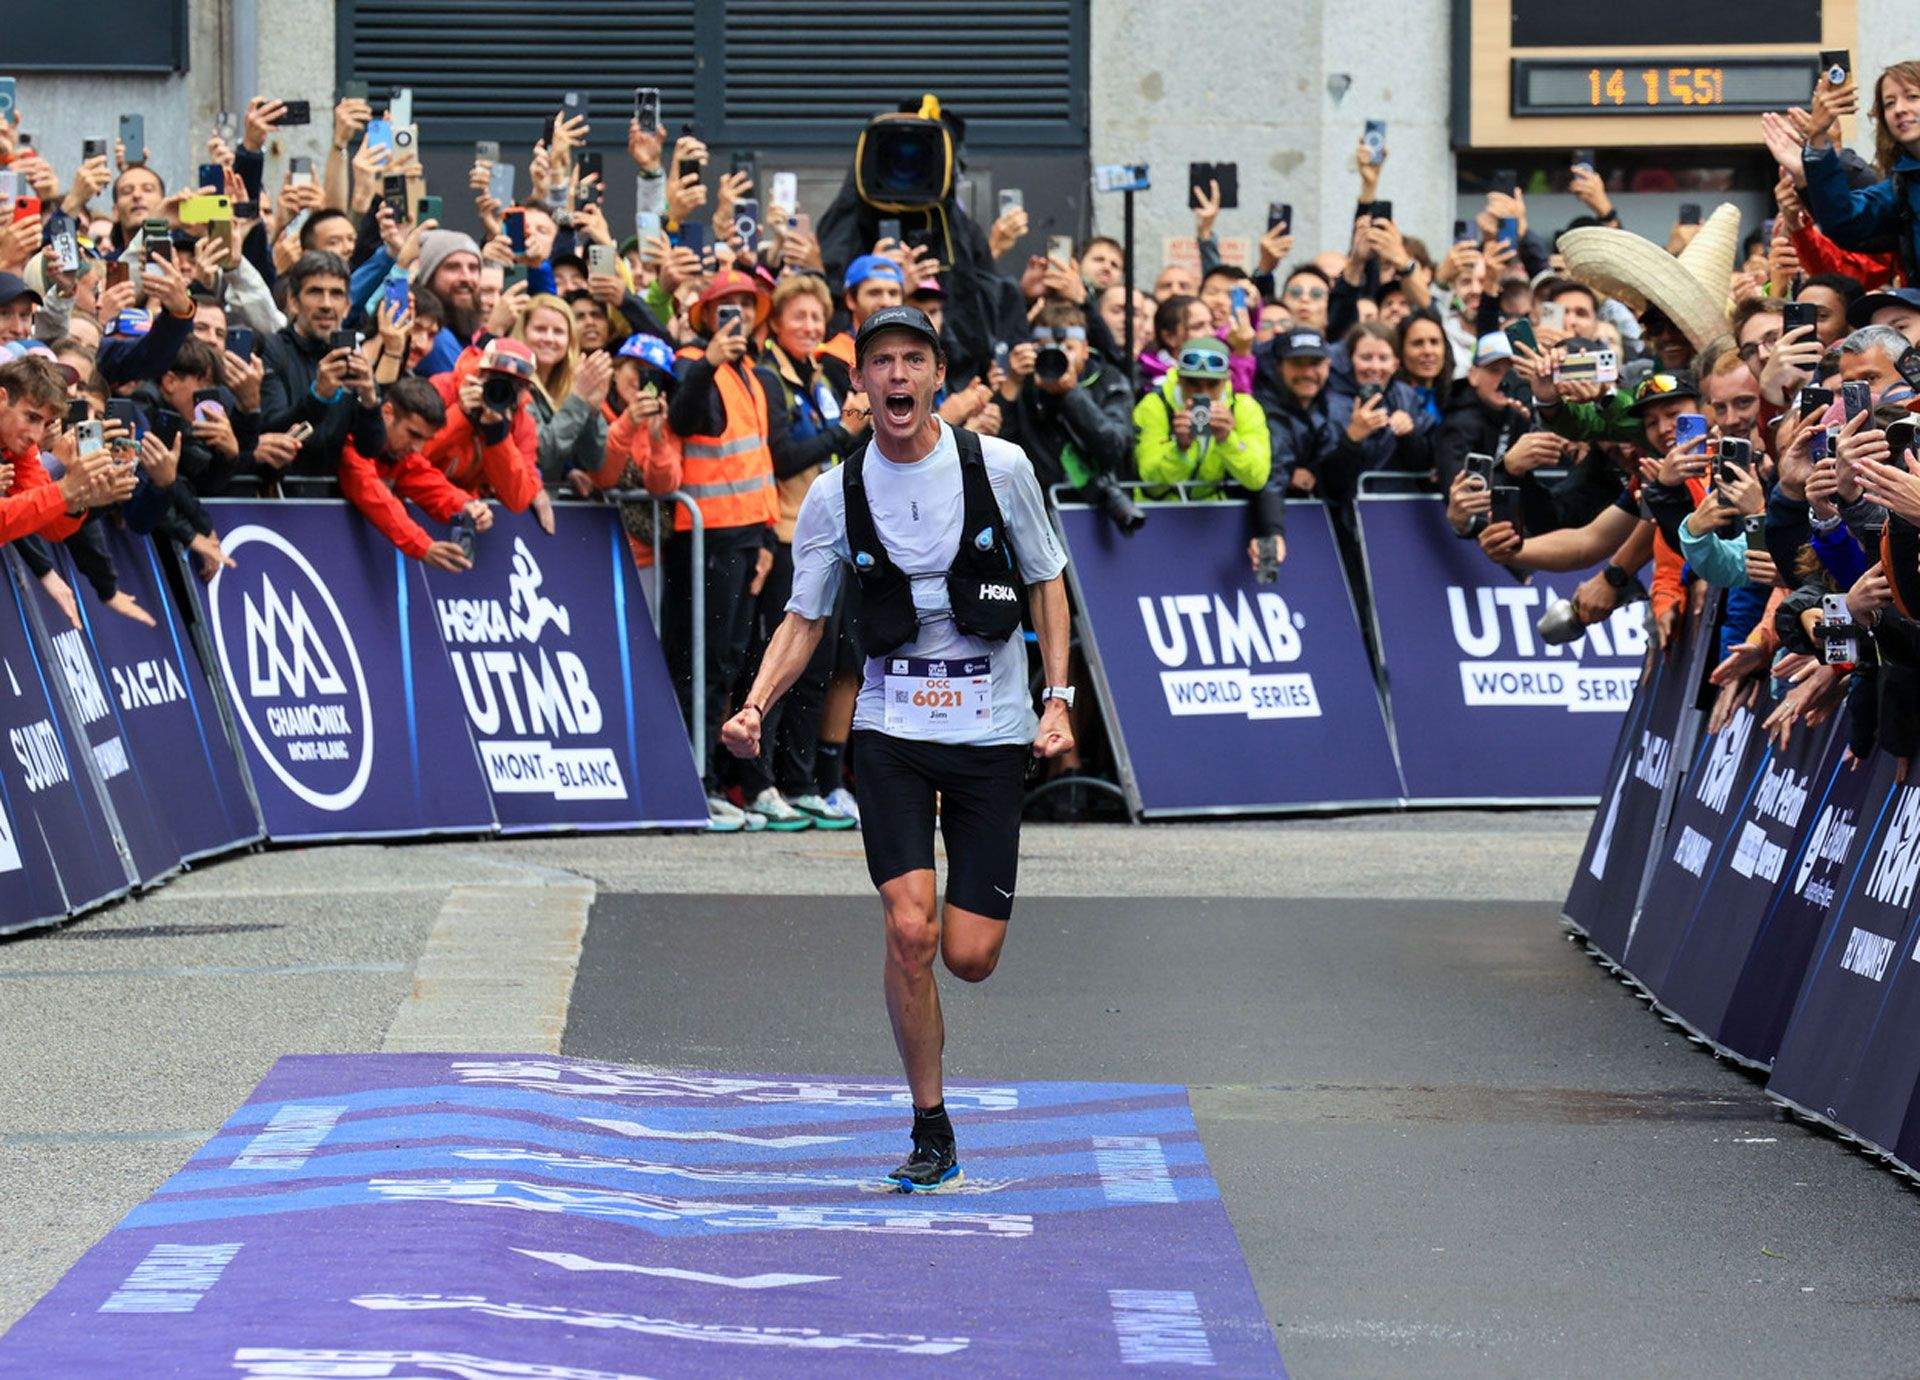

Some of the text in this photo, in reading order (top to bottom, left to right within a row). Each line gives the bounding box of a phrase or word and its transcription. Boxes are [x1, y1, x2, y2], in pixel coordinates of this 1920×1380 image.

[1590, 68, 1625, 105] 14
[874, 309, 908, 325] HOKA
[979, 584, 1018, 602] HOKA
[437, 598, 514, 643] HOKA
[111, 657, 187, 710] DACIA
[450, 644, 603, 738] UTMB
[926, 679, 951, 690] OCC
[1171, 680, 1312, 709] WORLD SERIES
[1473, 672, 1564, 695] WORLD
[912, 689, 963, 708] 6021
[266, 703, 352, 738] CHAMONIX
[928, 709, 949, 721] Jim
[9, 718, 70, 793] SUUNTO
[287, 740, 350, 762] MONT-BLANC
